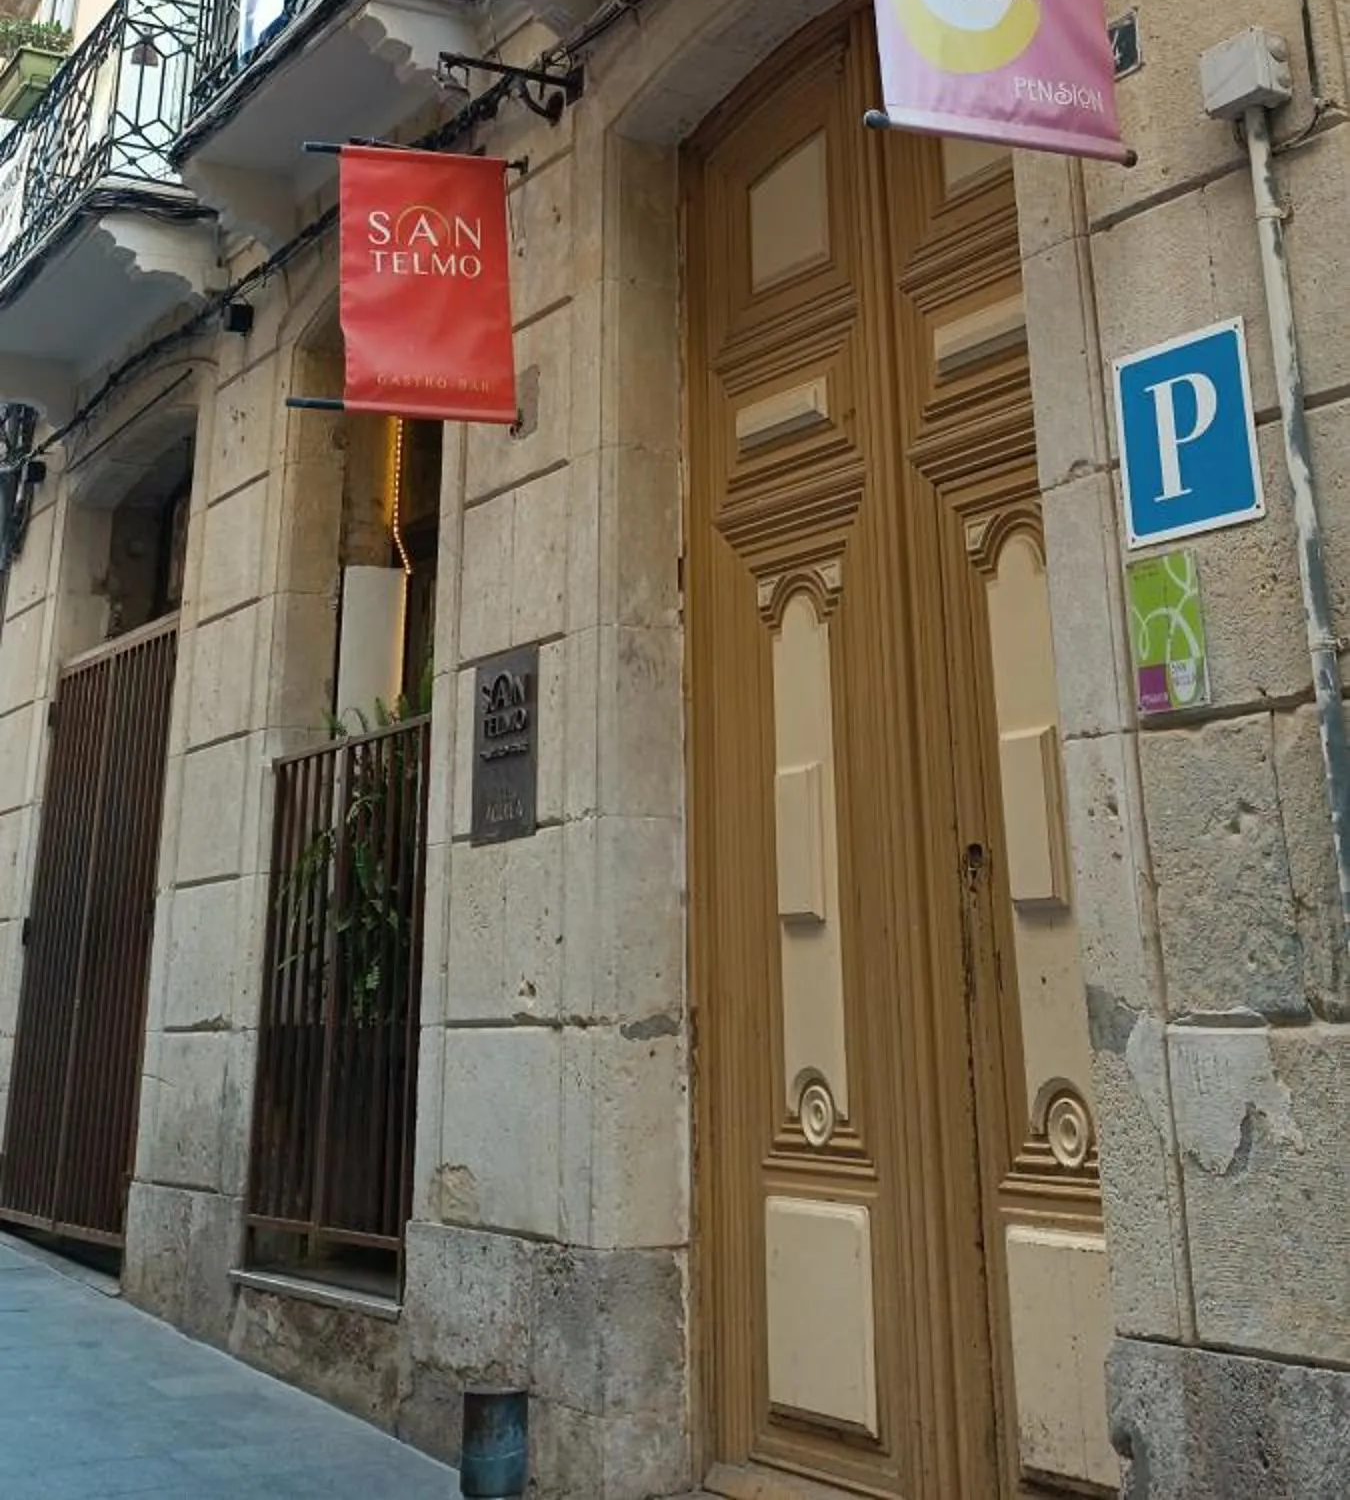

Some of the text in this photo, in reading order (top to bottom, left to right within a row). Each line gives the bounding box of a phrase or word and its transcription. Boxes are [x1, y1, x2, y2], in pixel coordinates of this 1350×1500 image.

[368, 210, 481, 251] SAN
[369, 250, 482, 279] TELMO
[1143, 372, 1218, 504] P
[481, 669, 532, 715] SAN
